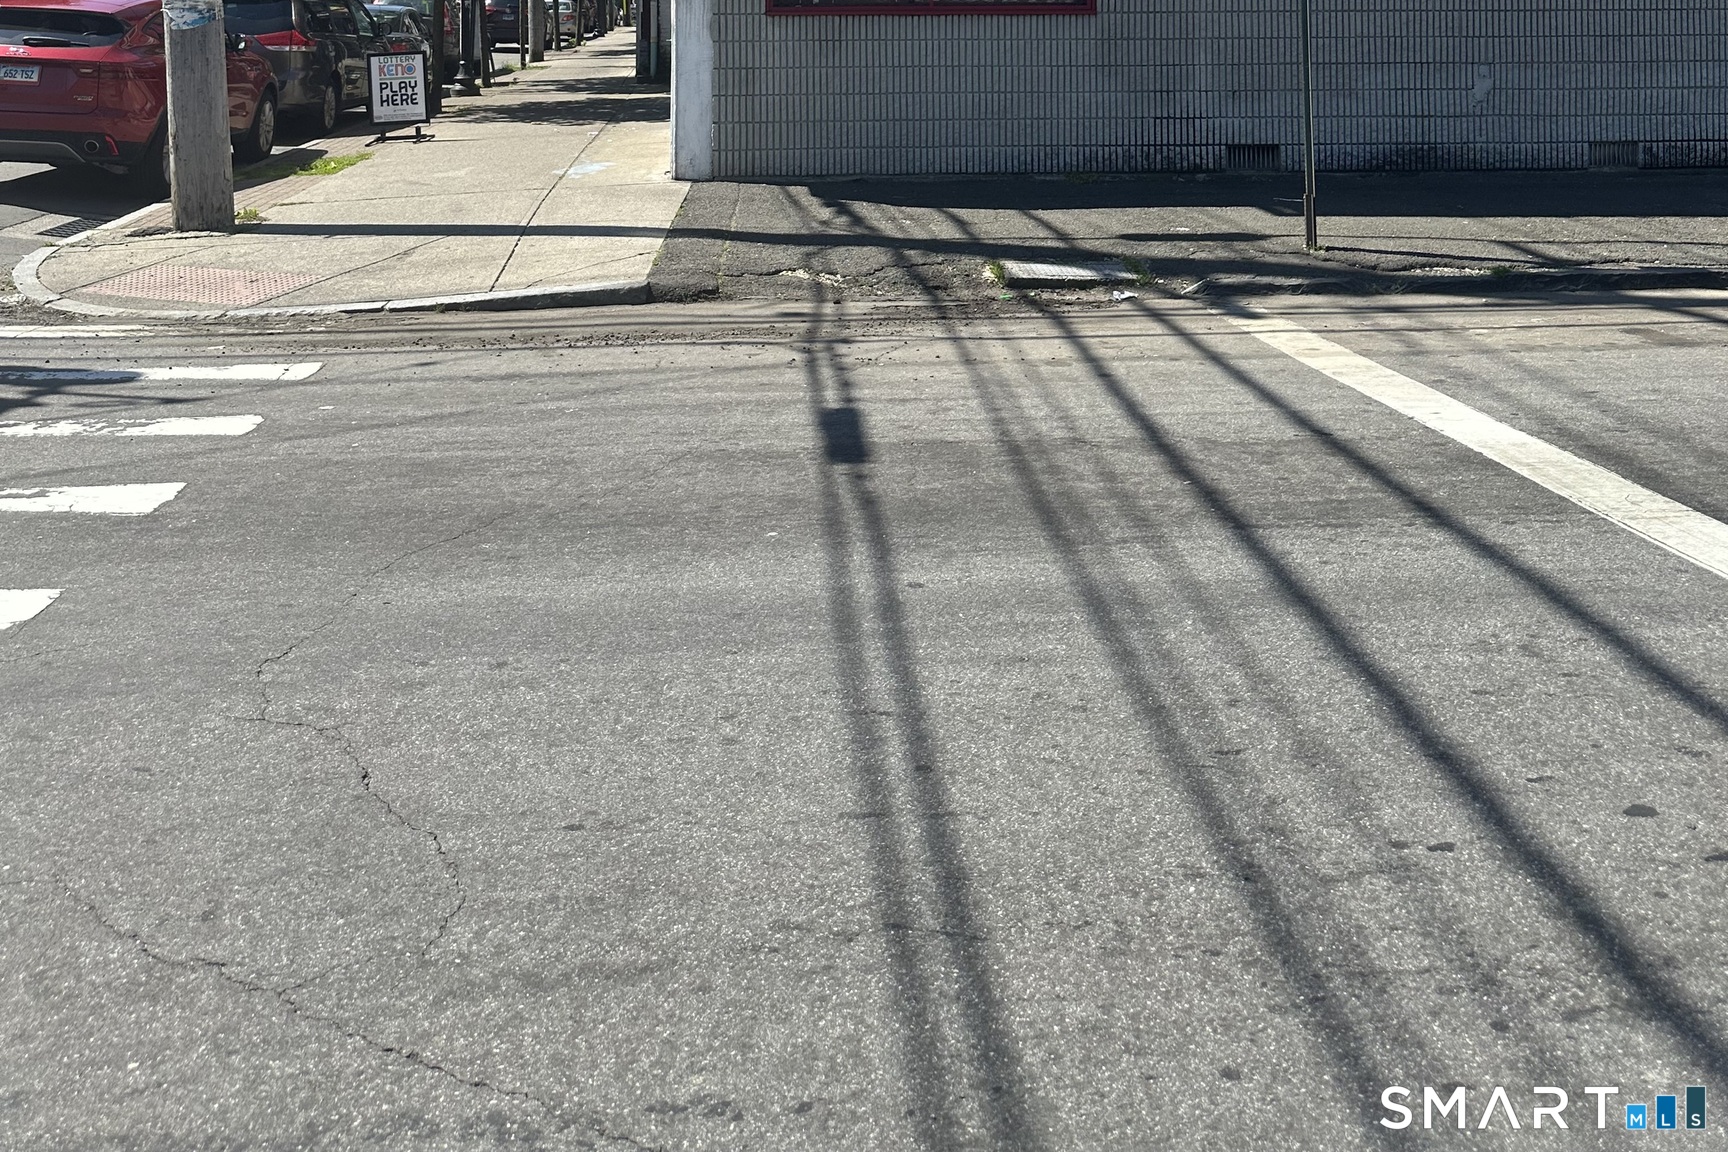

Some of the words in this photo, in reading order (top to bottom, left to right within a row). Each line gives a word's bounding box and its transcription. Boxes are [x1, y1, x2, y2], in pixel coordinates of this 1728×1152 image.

[378, 55, 416, 65] LOTTERY
[378, 63, 417, 77] KENO
[379, 80, 418, 94] PLAY
[380, 92, 419, 107] HERE
